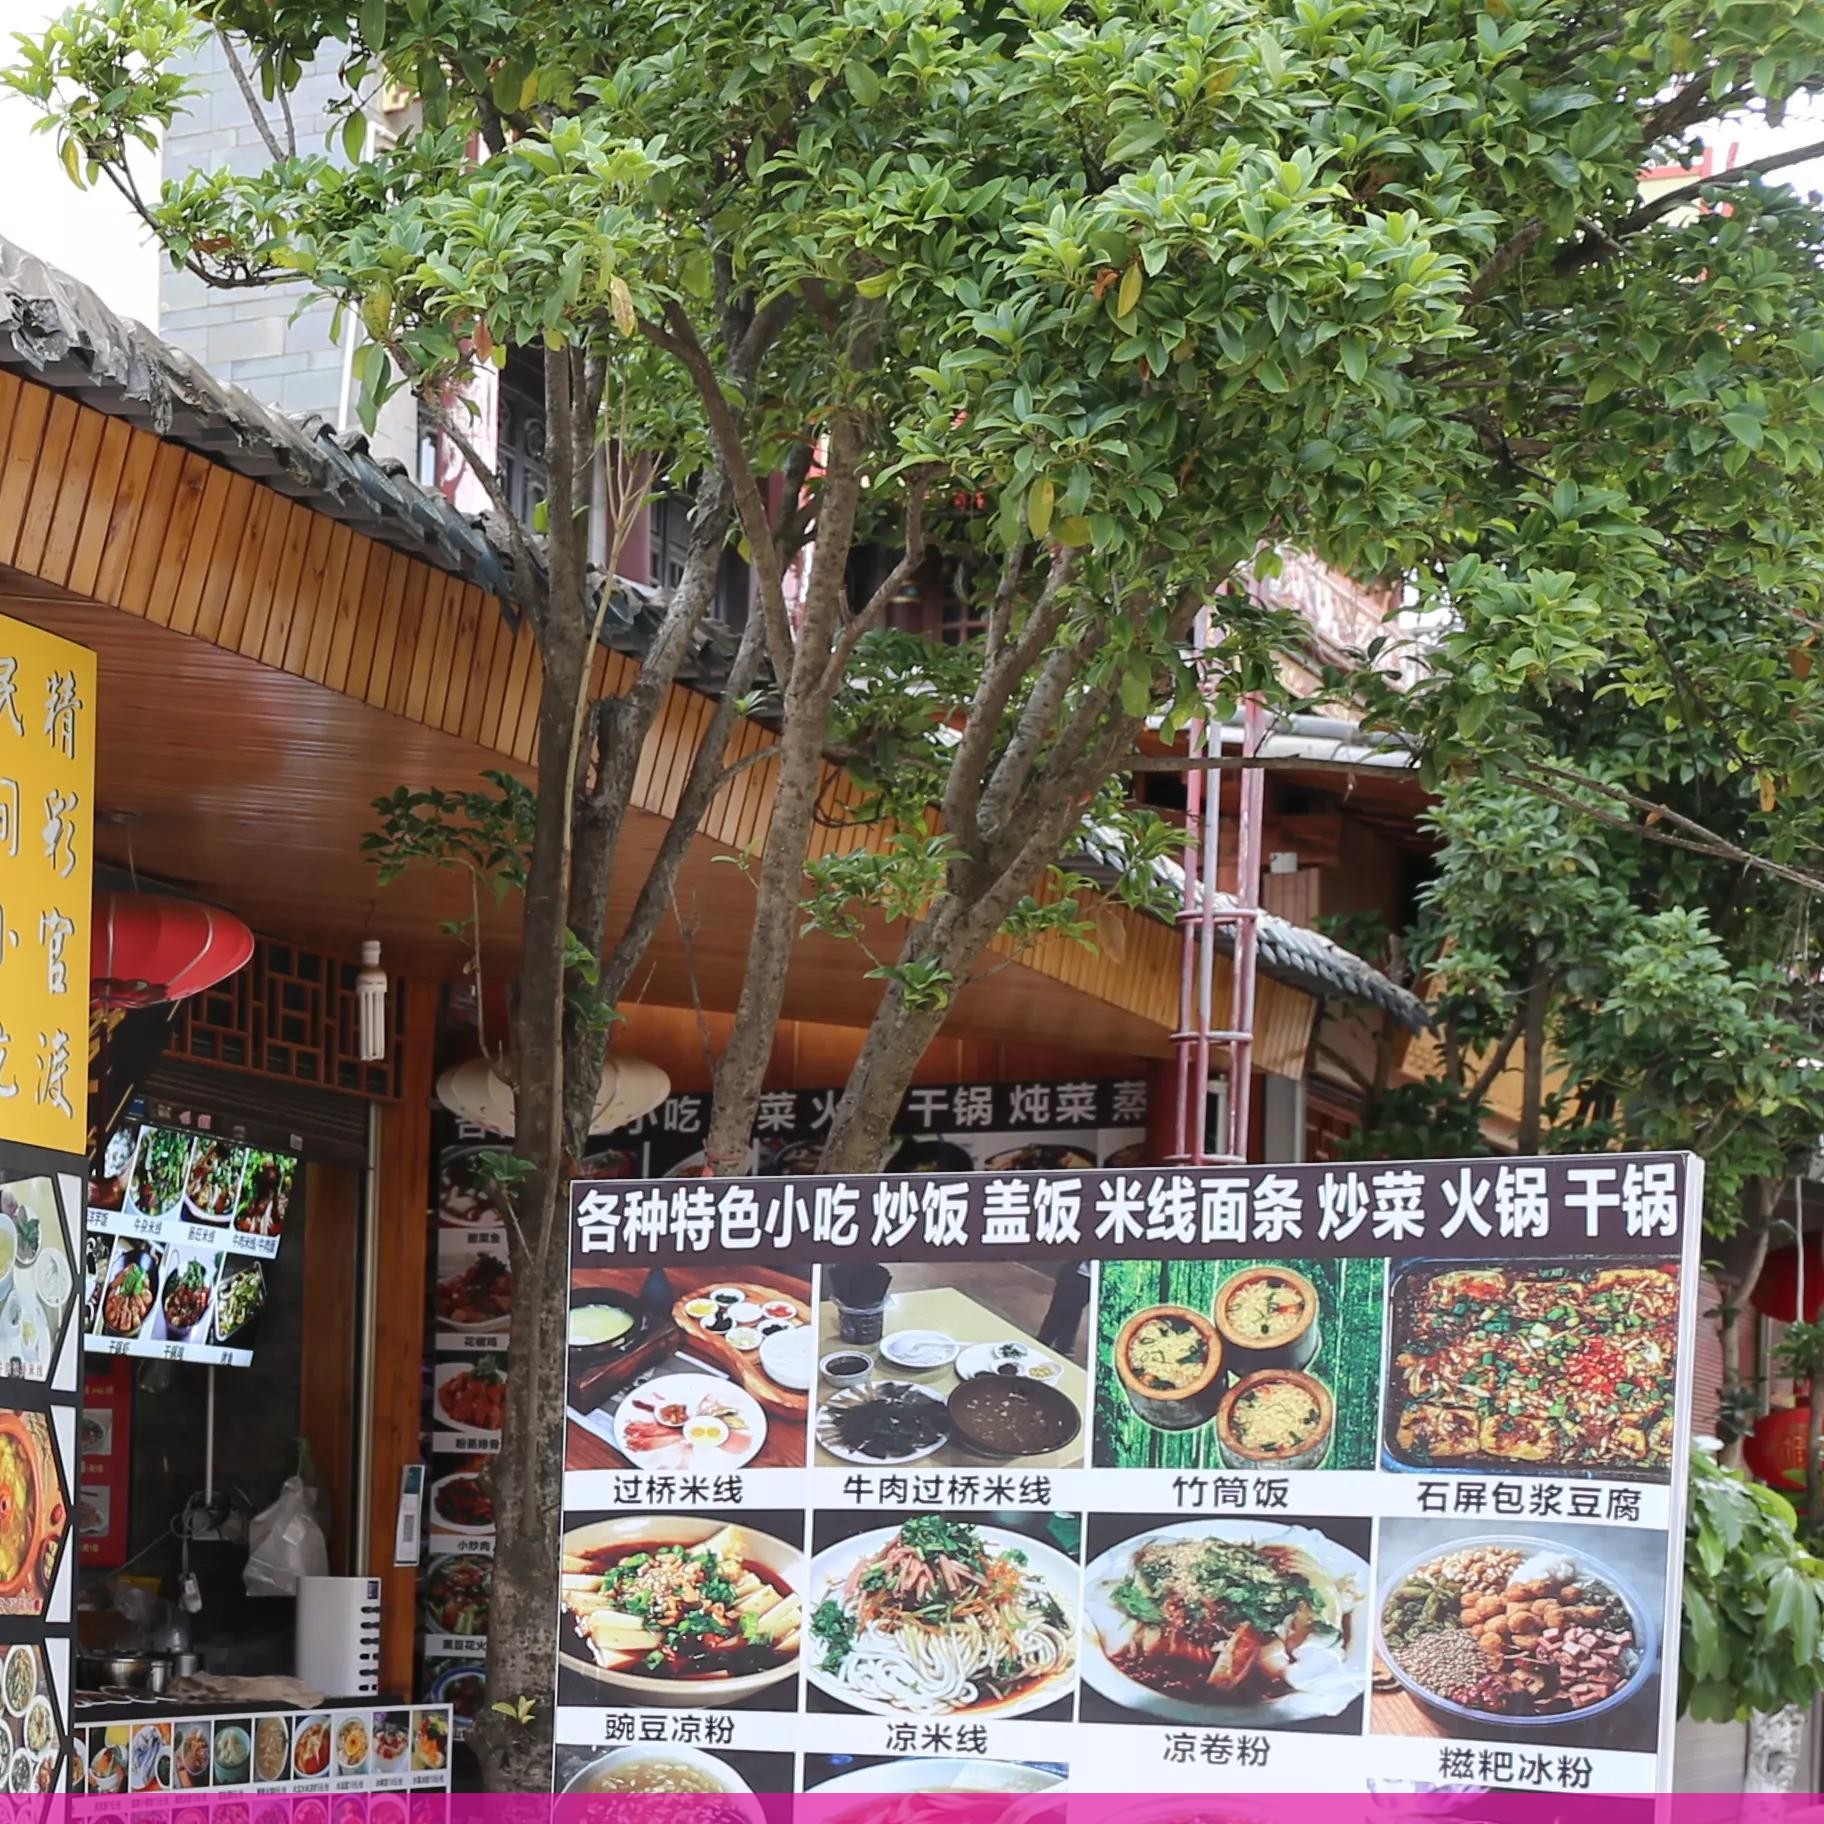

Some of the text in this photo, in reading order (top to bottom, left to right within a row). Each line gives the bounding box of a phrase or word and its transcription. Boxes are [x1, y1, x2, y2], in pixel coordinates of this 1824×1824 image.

[34, 669, 84, 1119] 精彩官渡
[909, 1088, 992, 1128] 干锅
[1009, 1085, 1099, 1125] 炖菜
[578, 1164, 1676, 1252] 各种特色小吃 炒饭 盖饭 米线面条 炒菜 火锅 干锅
[614, 1475, 1640, 1521] 过桥米线 牛肉过桥米线 竹筒饭 石屏包浆豆腐
[606, 1714, 734, 1743] 豌豆凉粉
[887, 1723, 986, 1754] 凉米线
[1165, 1733, 1269, 1766] 凉卷粉
